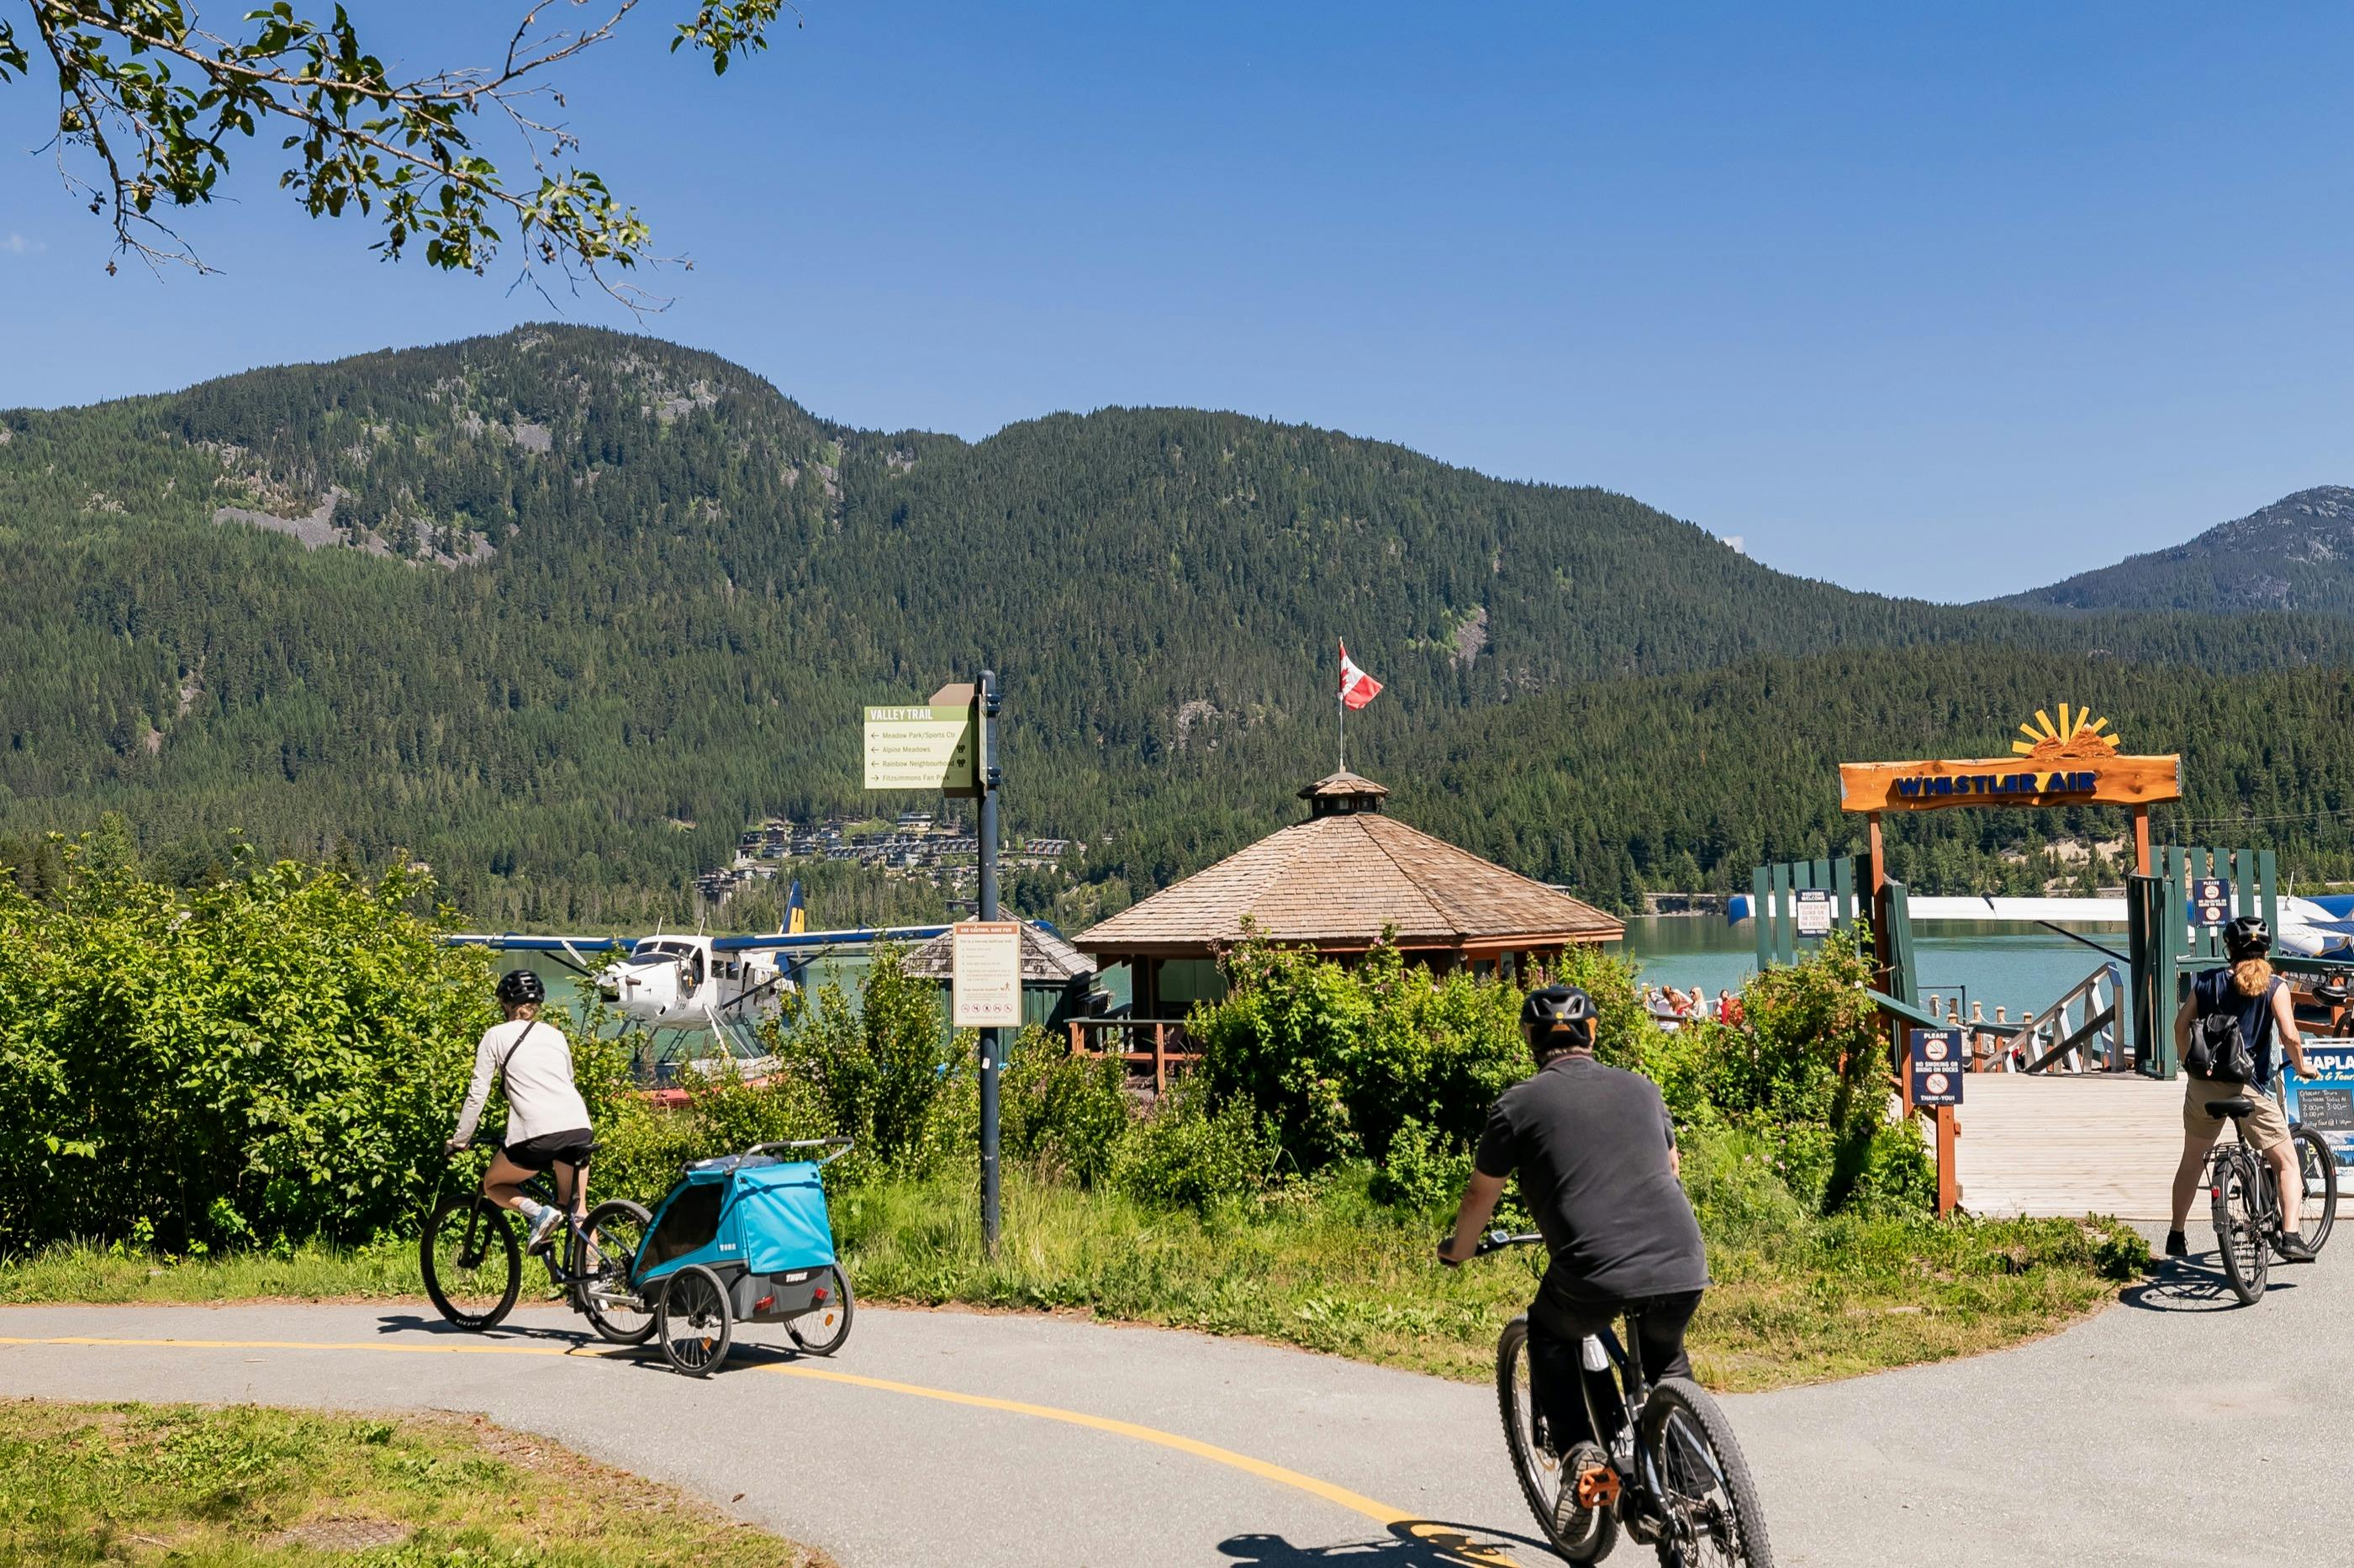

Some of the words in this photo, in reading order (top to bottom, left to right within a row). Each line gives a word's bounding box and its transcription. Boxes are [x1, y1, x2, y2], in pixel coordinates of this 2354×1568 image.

[870, 709, 905, 721] VALLEY
[907, 708, 933, 721] TRAIL
[909, 731, 944, 740] Park/Sports
[910, 759, 955, 768] Neighbourhood
[1895, 773, 2039, 795] WHISTLER
[2045, 771, 2098, 793] AIR
[2303, 1055, 2354, 1069] EAPLA
[786, 1271, 808, 1283] THULE
